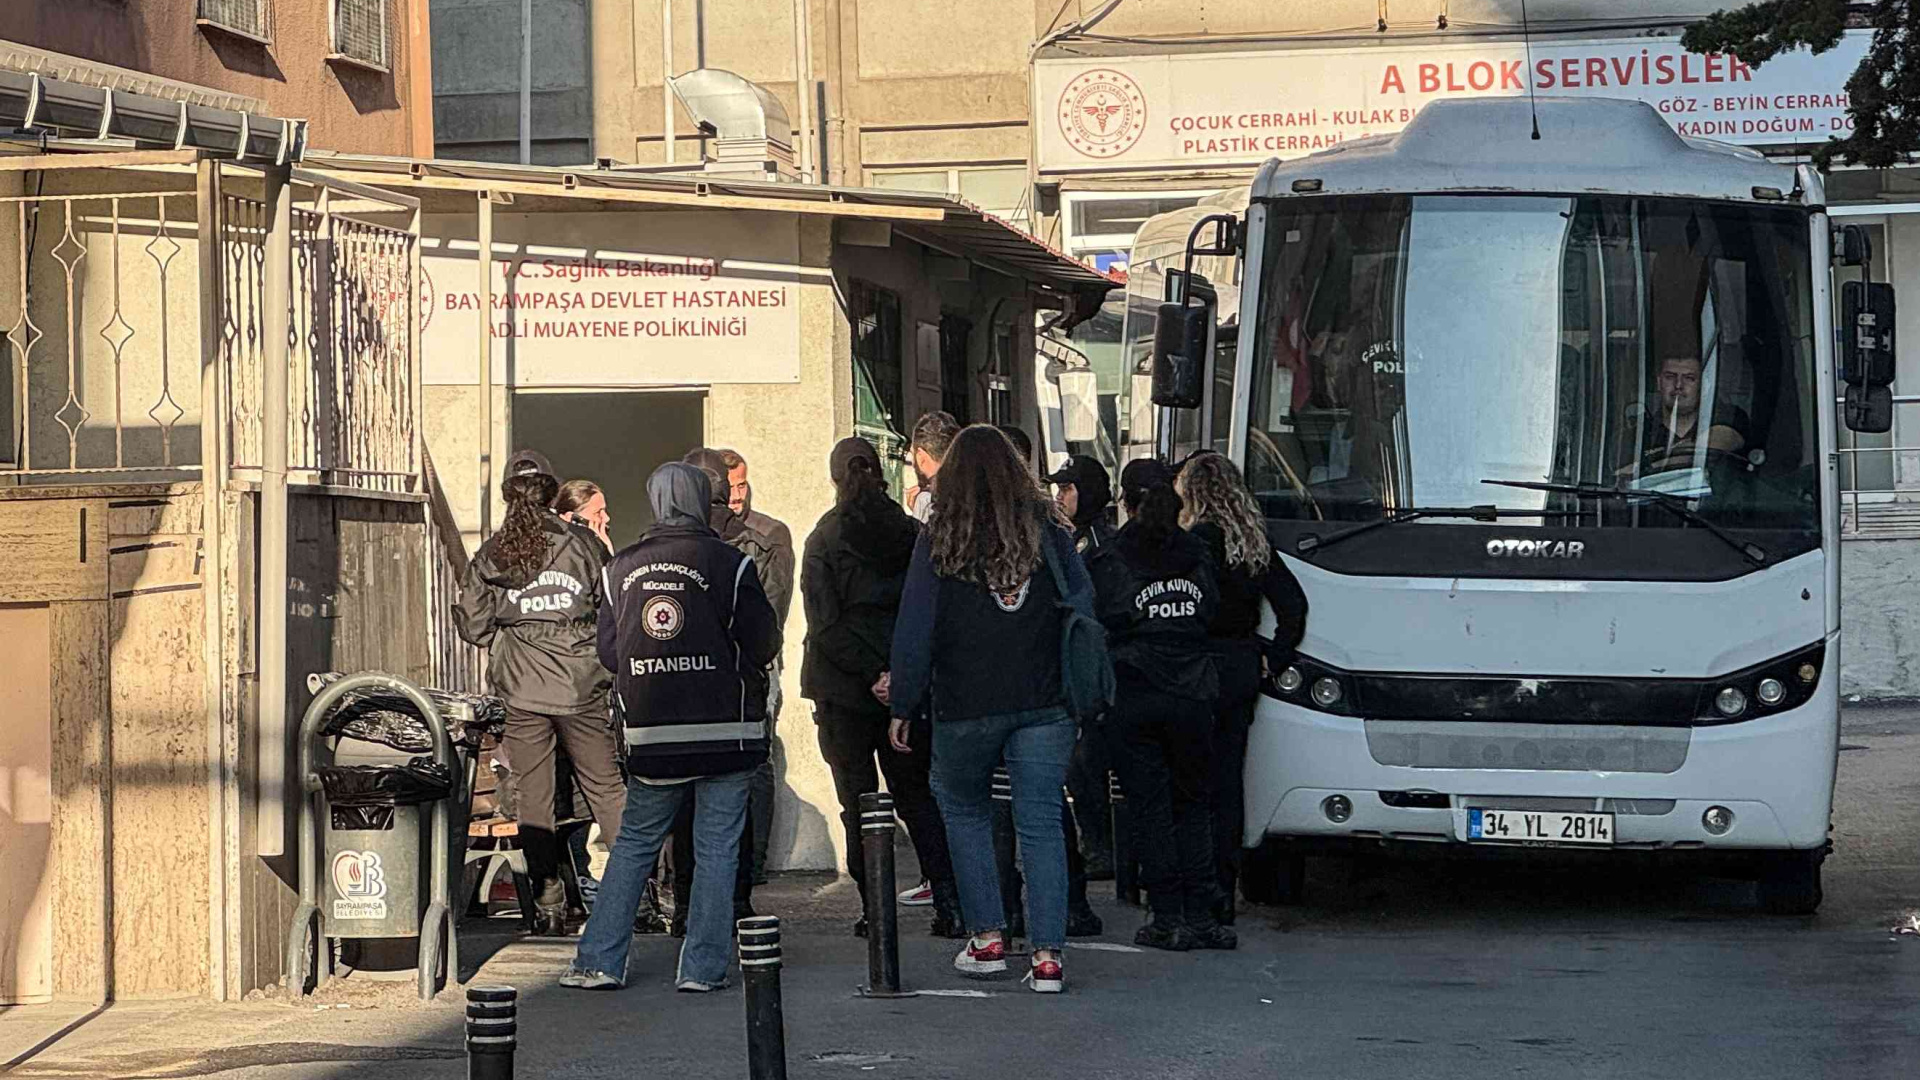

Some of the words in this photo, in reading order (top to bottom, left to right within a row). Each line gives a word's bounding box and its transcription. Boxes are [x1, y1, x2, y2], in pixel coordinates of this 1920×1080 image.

[1380, 64, 1405, 94] A
[1419, 60, 1525, 93] BLOK
[1659, 96, 1698, 113] GÖZ
[1714, 94, 1768, 111] BEYİN
[1774, 93, 1847, 109] CERRAH
[1170, 114, 1233, 135] ÇOCUK
[1238, 109, 1317, 128] CERRAHİ
[1333, 109, 1394, 125] KULAK
[1678, 120, 1736, 135] KADIN
[1743, 116, 1814, 134] DOĞUM
[1184, 133, 1259, 154] PLASTİK
[1264, 131, 1342, 151] CERRAHİ
[542, 258, 610, 282] Sağlık
[616, 256, 720, 282] Bakanlığı
[445, 291, 586, 313] BAYRAMPAŞA
[591, 291, 668, 309] DEVLET
[673, 286, 786, 308] HASTANESİ
[534, 320, 629, 338] MUAYENE
[634, 316, 747, 337] POLİKLİNİĞİ
[1487, 539, 1584, 558] OTOKAR
[622, 564, 650, 591] GÖÇMEN
[643, 581, 685, 591] MÜCADELE
[1135, 581, 1165, 610] ÇEVİK
[1167, 578, 1203, 604] KUVVET
[1148, 600, 1196, 618] POLİS
[630, 655, 717, 676] İSTANBUL
[1484, 813, 1509, 836] 34
[1524, 814, 1548, 837] YL
[1561, 816, 1608, 839] 2814
